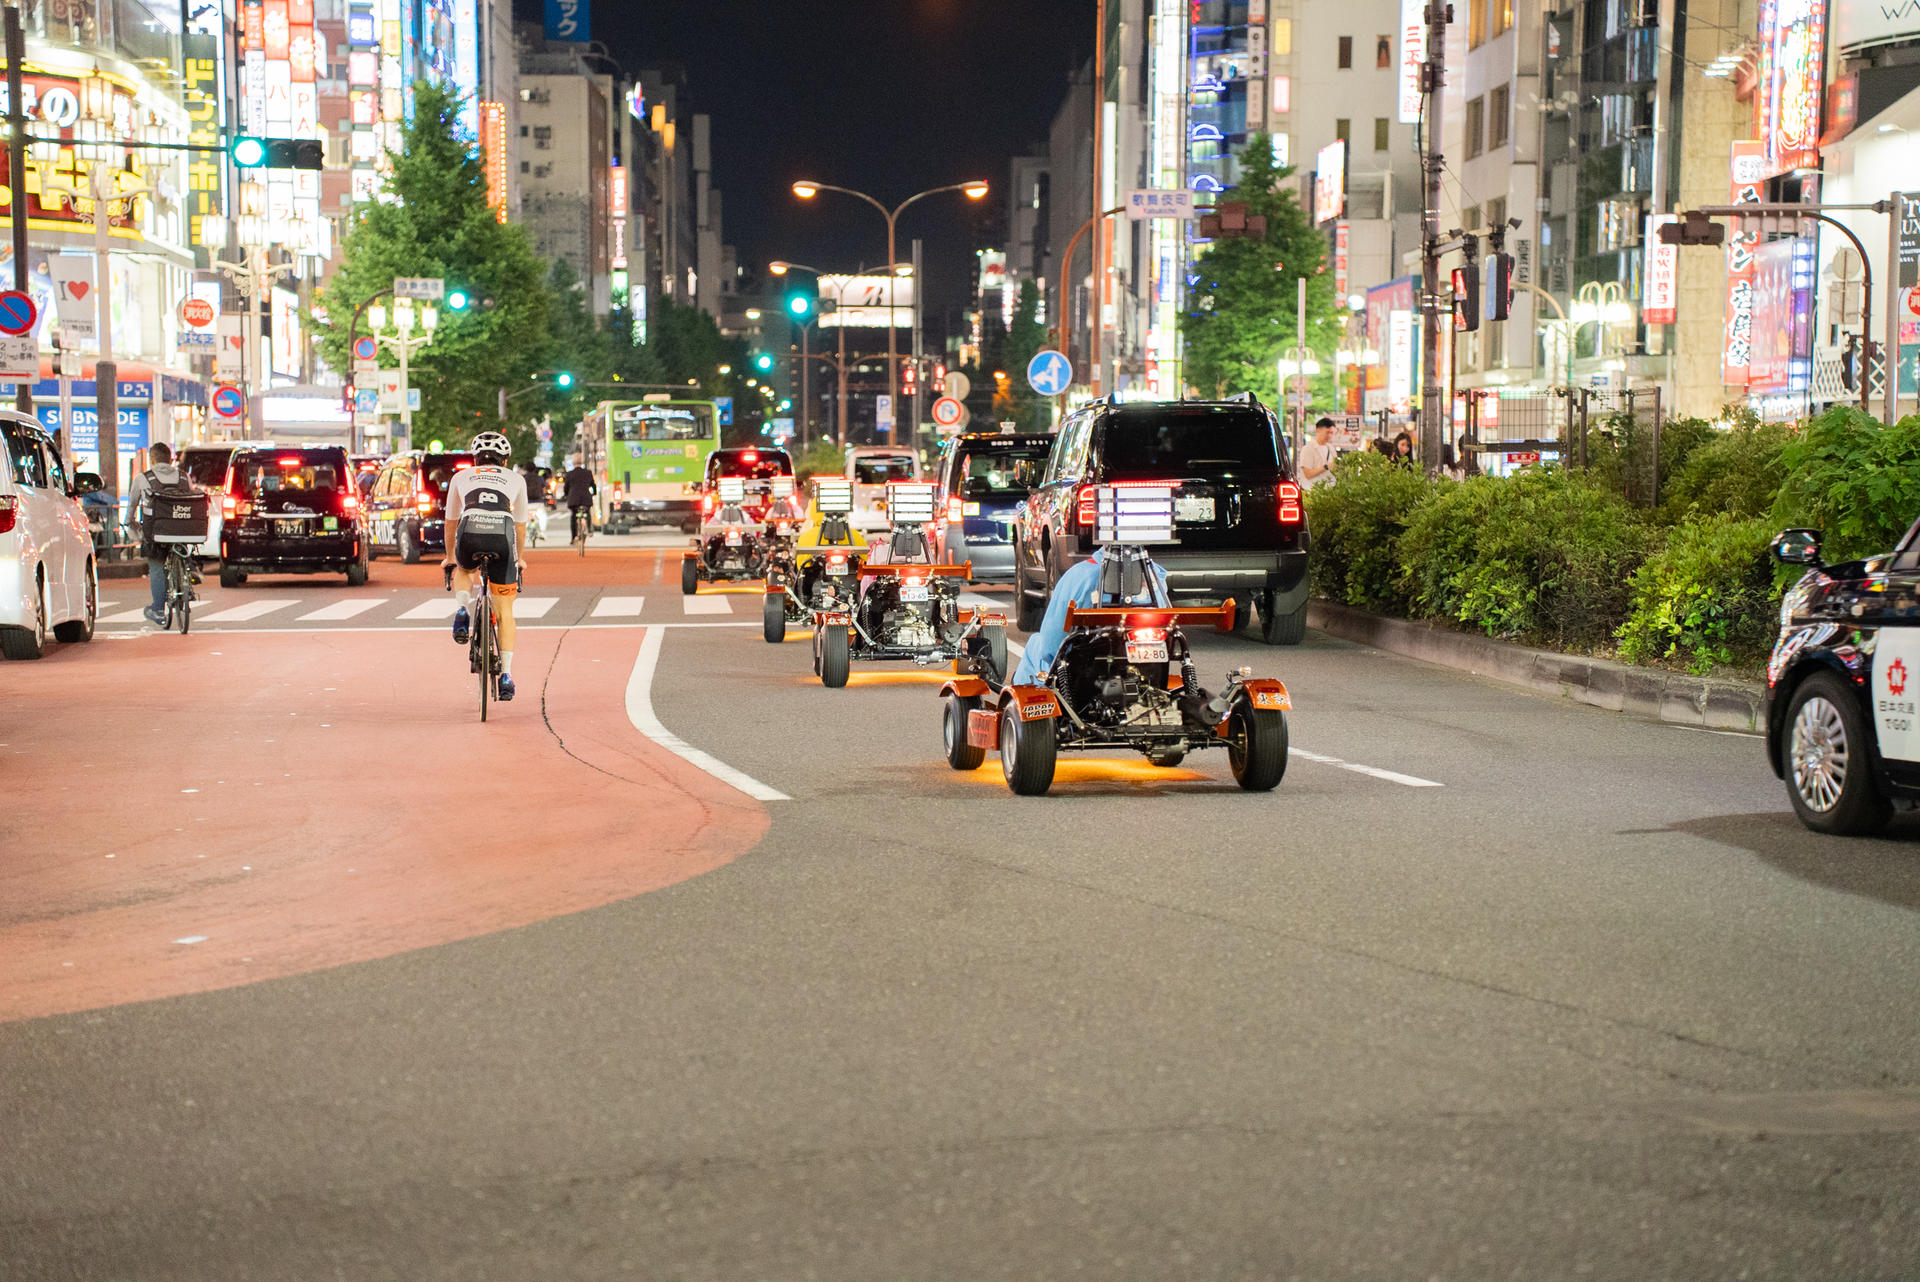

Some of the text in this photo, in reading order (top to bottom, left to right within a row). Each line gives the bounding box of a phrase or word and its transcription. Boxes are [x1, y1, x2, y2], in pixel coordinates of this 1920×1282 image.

[558, 0, 578, 37] ック
[1133, 194, 1187, 206] 歌舞伎町
[46, 410, 140, 425] SBNDE
[173, 504, 191, 512] Uber
[173, 511, 191, 519] Eats
[1257, 692, 1287, 705] 東京
[1022, 703, 1055, 713] JAPAN
[1880, 700, 1915, 714] 日本交通
